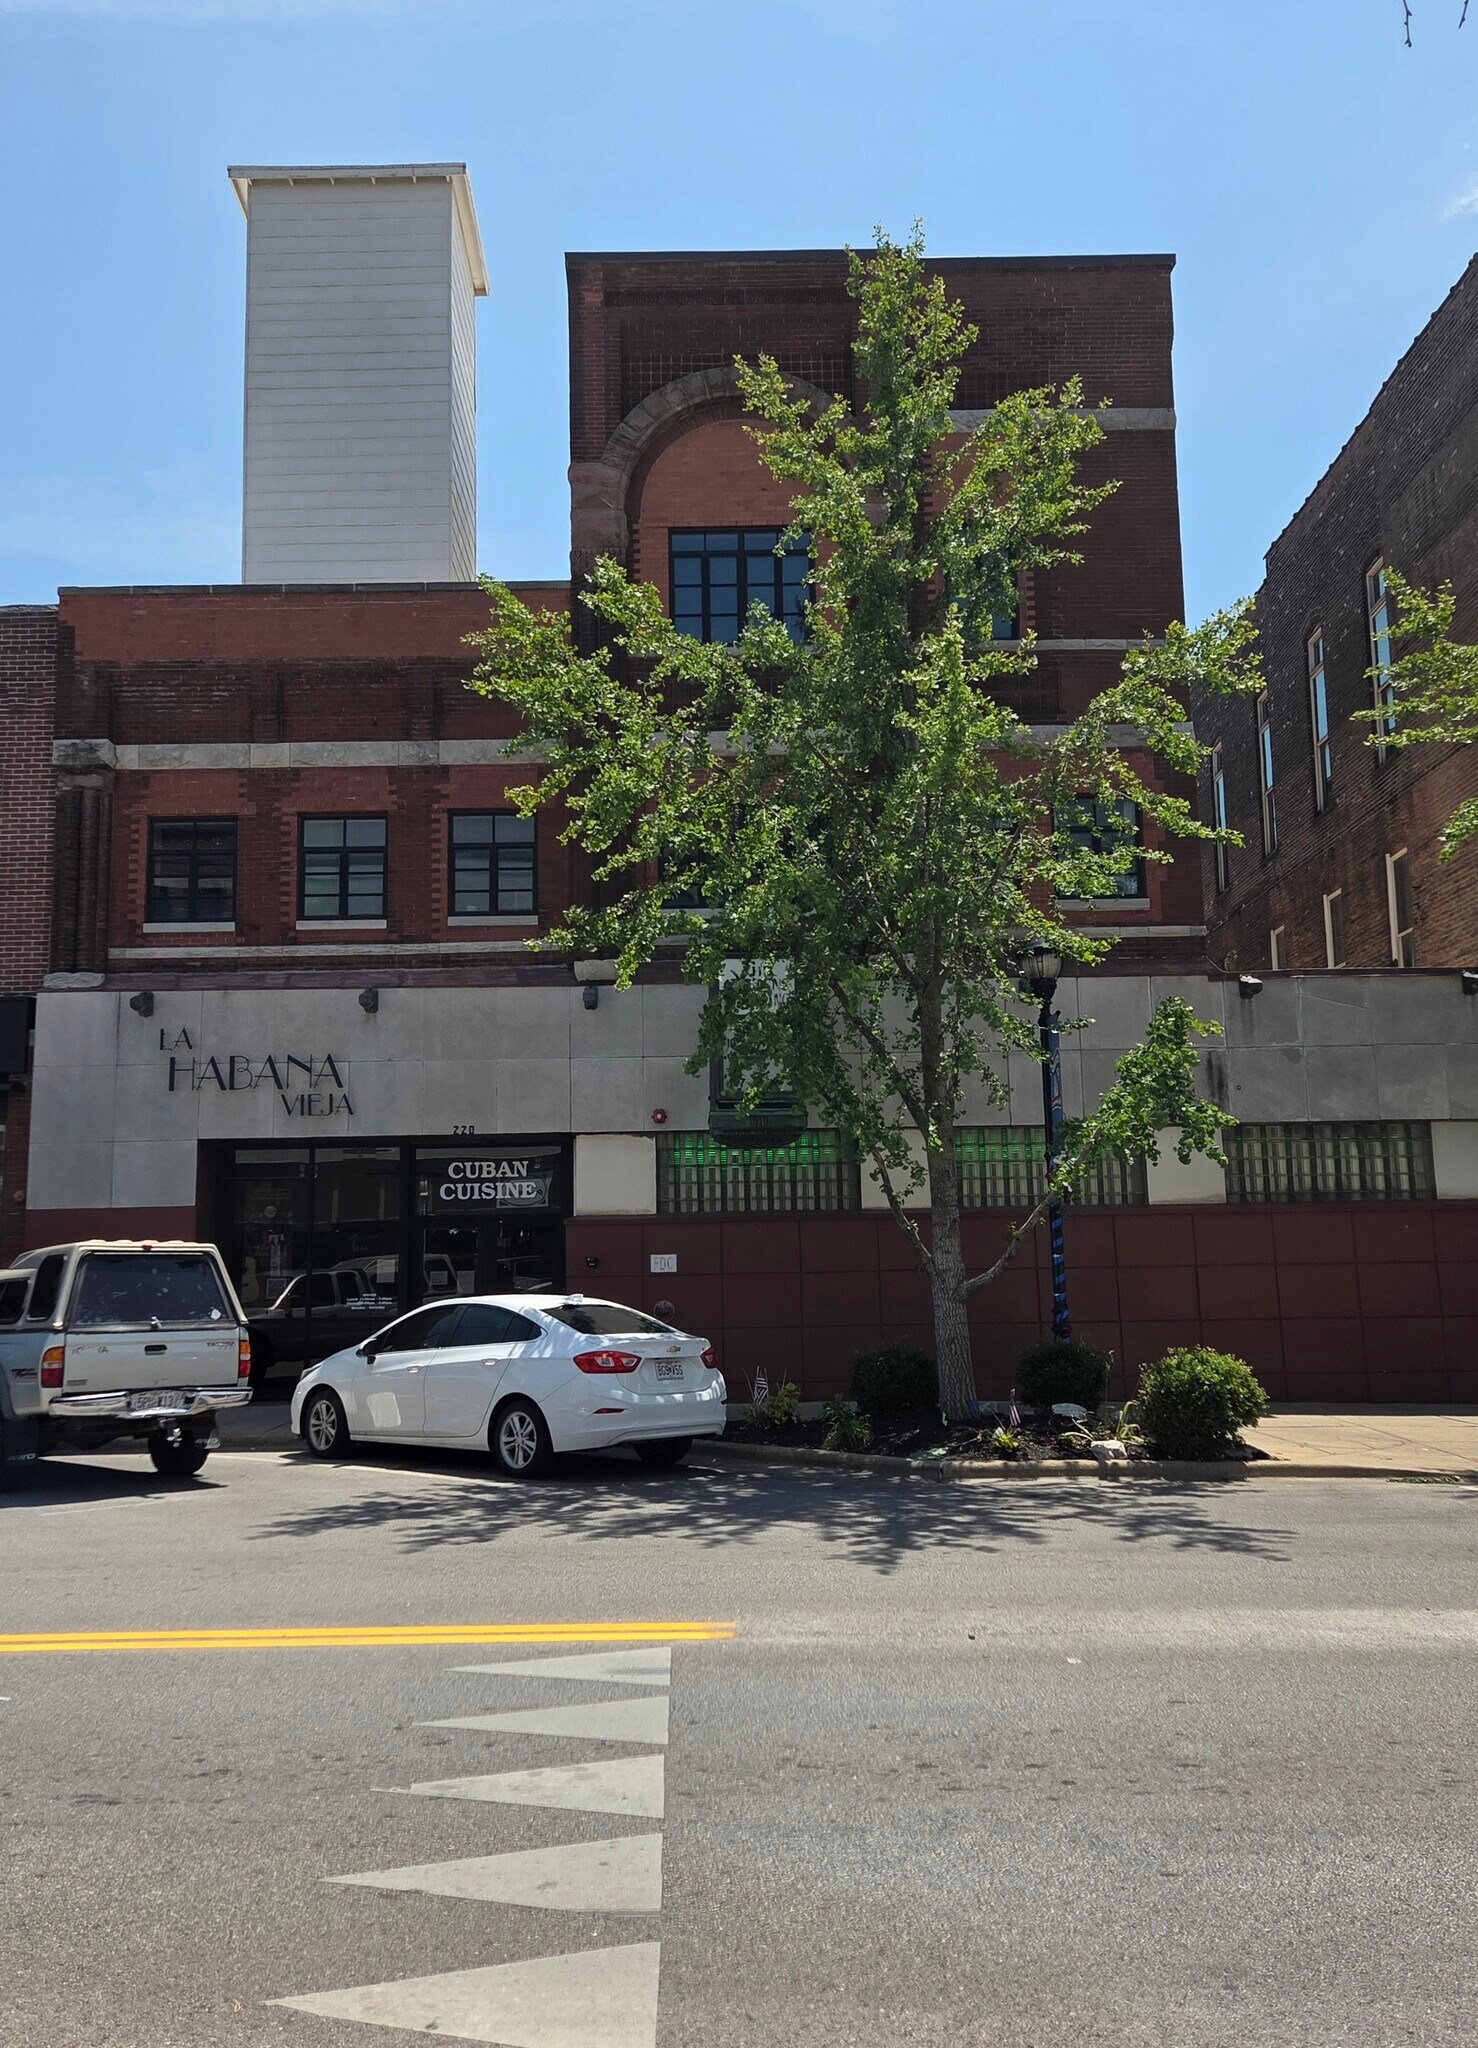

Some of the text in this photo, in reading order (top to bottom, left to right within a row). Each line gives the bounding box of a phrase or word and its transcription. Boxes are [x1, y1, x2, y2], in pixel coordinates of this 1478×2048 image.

[159, 1027, 193, 1051] LA
[168, 1053, 344, 1092] HABANA
[280, 1093, 354, 1117] VIEJA
[453, 1125, 475, 1135] 220
[447, 1161, 529, 1179] CUBAN
[439, 1182, 537, 1200] CUISINE
[653, 1256, 675, 1271] FDC
